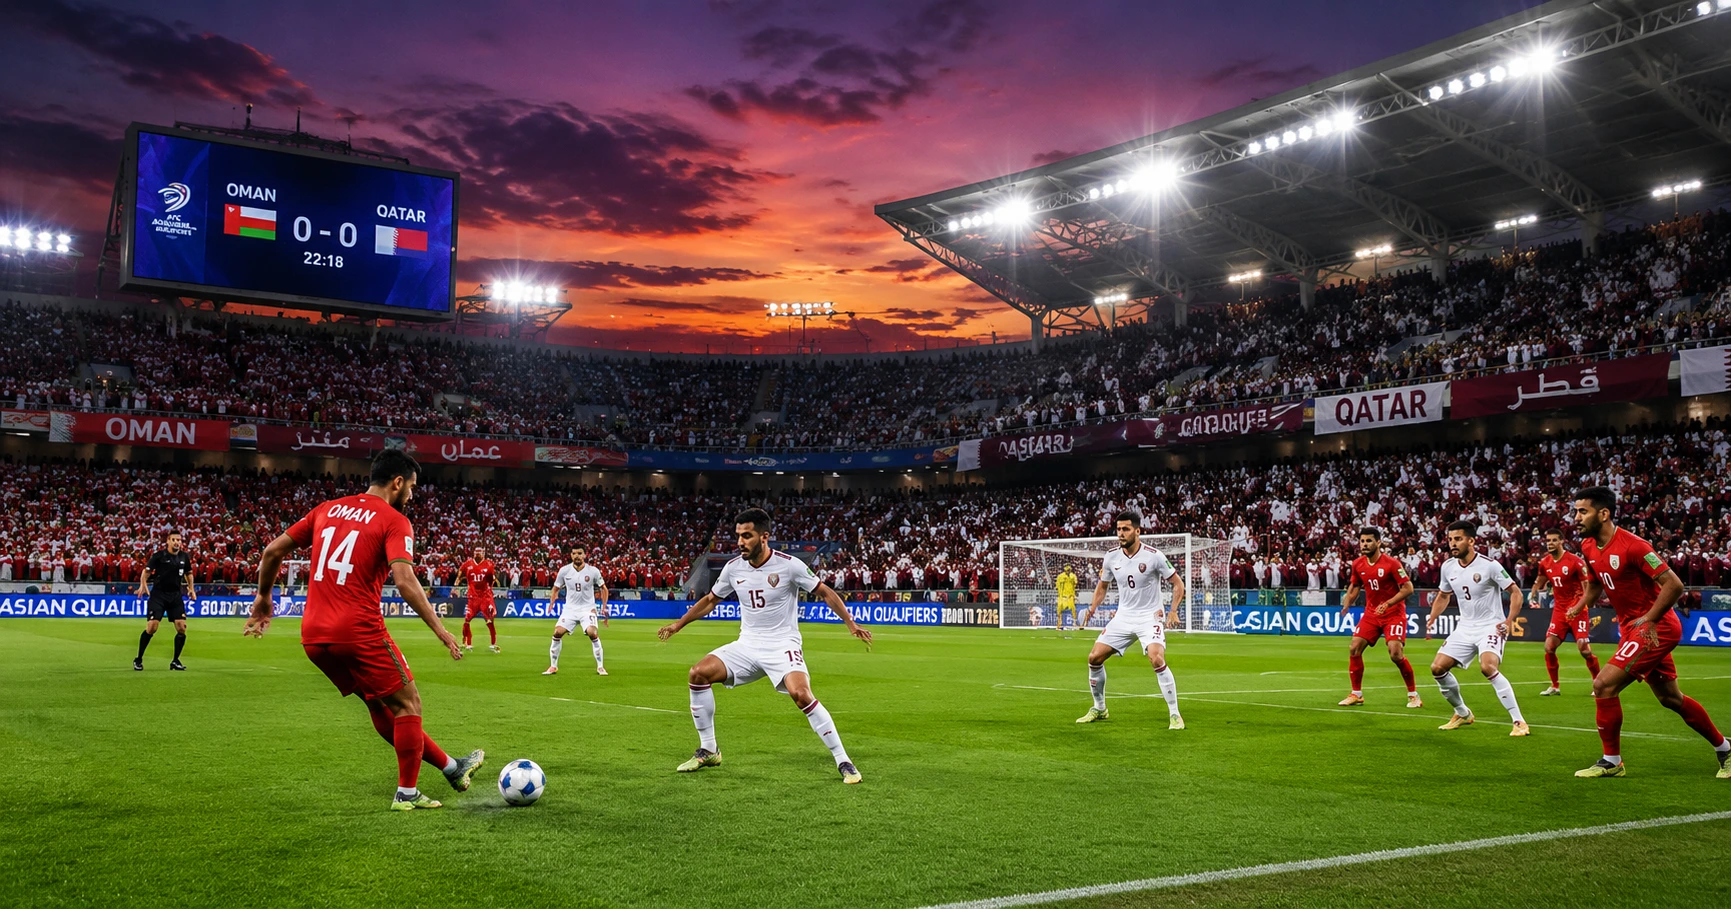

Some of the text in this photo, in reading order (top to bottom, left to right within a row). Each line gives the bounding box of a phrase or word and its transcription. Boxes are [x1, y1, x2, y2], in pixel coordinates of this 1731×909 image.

[226, 182, 277, 203] OMAN
[376, 204, 427, 224] QATAR
[292, 216, 312, 242] 0
[338, 223, 358, 248] 0
[303, 251, 344, 269] 22:18
[1507, 365, 1601, 410] قطر
[1334, 389, 1429, 426] QATAR
[105, 417, 196, 445] OMAN
[327, 504, 377, 524] OMAN
[313, 526, 360, 586] 14
[1127, 574, 1136, 589] 6
[1367, 578, 1380, 591] 19
[1599, 572, 1616, 590] 10
[748, 589, 766, 609] 15
[1462, 586, 1471, 601] 3
[0, 598, 66, 615] ASIAN
[1615, 640, 1640, 660] 10
